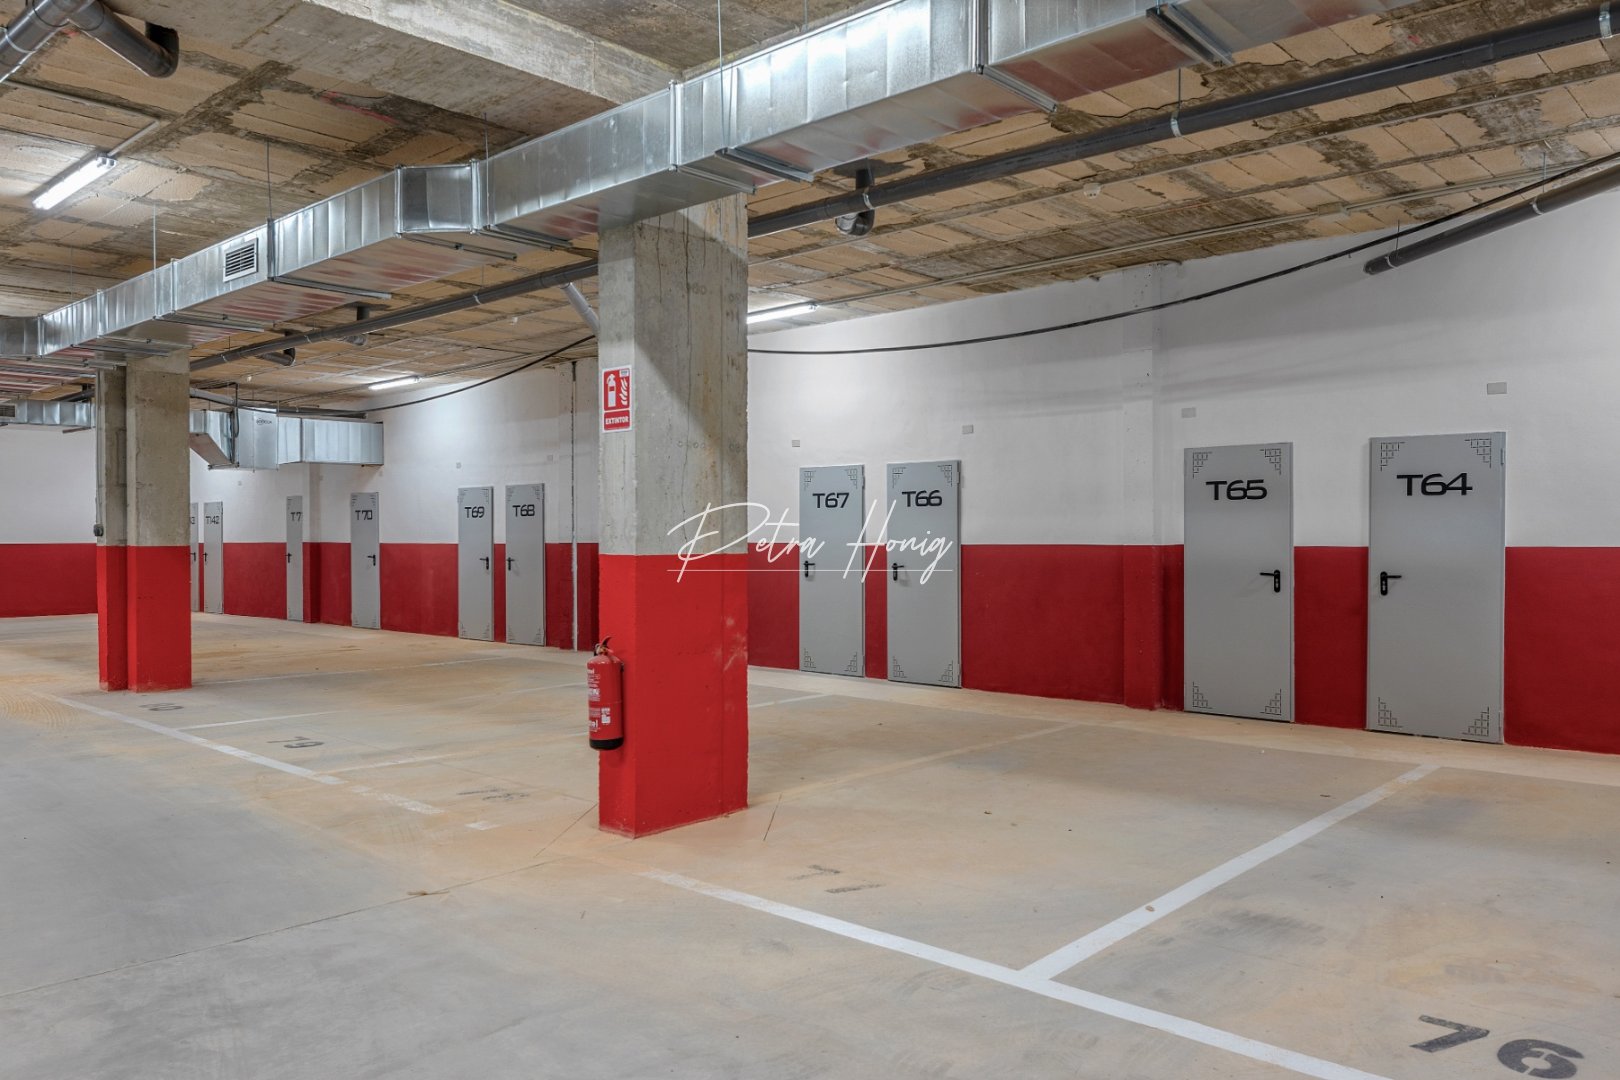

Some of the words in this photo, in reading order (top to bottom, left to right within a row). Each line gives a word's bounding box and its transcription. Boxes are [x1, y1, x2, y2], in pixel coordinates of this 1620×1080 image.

[1205, 478, 1268, 501] T65
[1396, 472, 1473, 497] T64
[812, 492, 850, 509] T67
[902, 490, 943, 508] T66
[354, 509, 373, 521] T70
[464, 506, 485, 519] T69
[512, 504, 536, 518] T68
[266, 735, 325, 749] 79
[1408, 1014, 1586, 1080] 76
